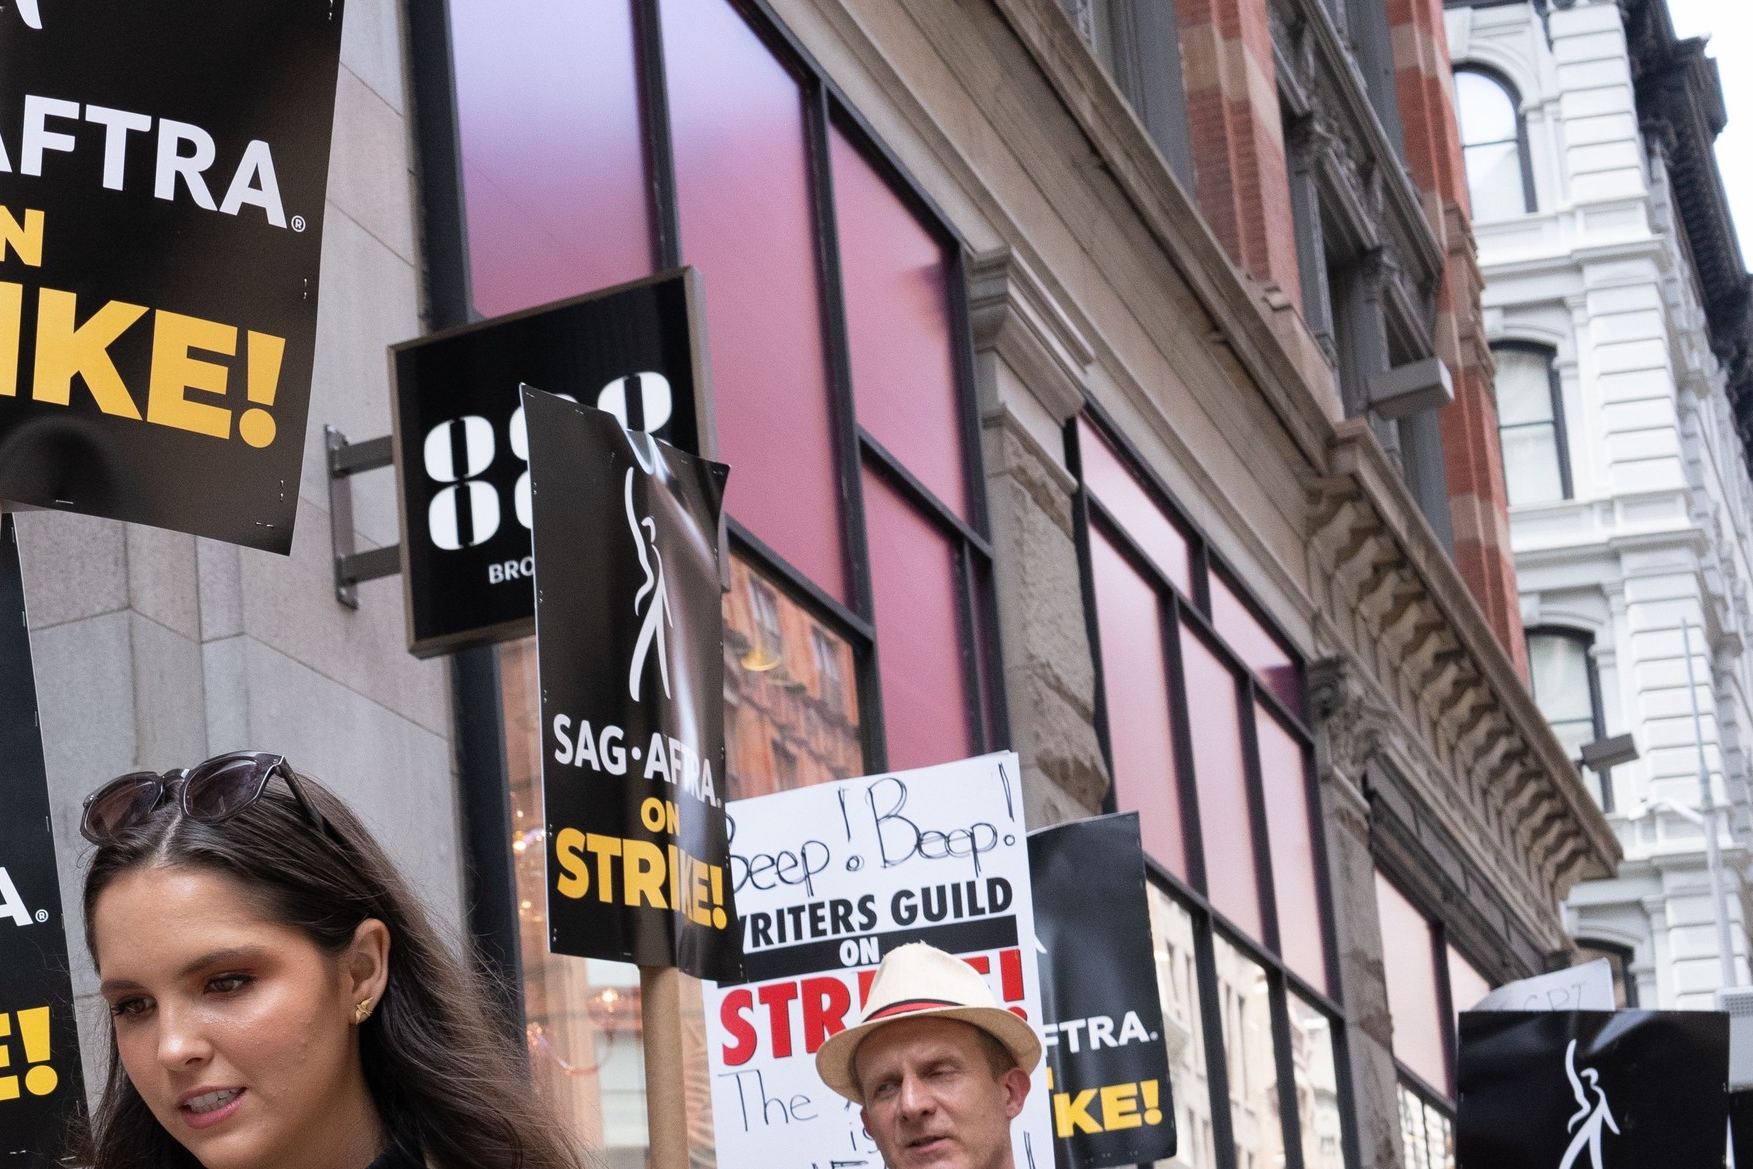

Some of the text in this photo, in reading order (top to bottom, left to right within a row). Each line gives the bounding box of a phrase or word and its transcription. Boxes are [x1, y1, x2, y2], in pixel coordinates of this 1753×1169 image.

[640, 797, 680, 836] ON
[865, 763, 1016, 878] Beep!
[555, 827, 728, 930] STRIKE!
[890, 877, 1013, 926] GUILD
[839, 936, 880, 967] ON
[718, 1069, 819, 1132] The
